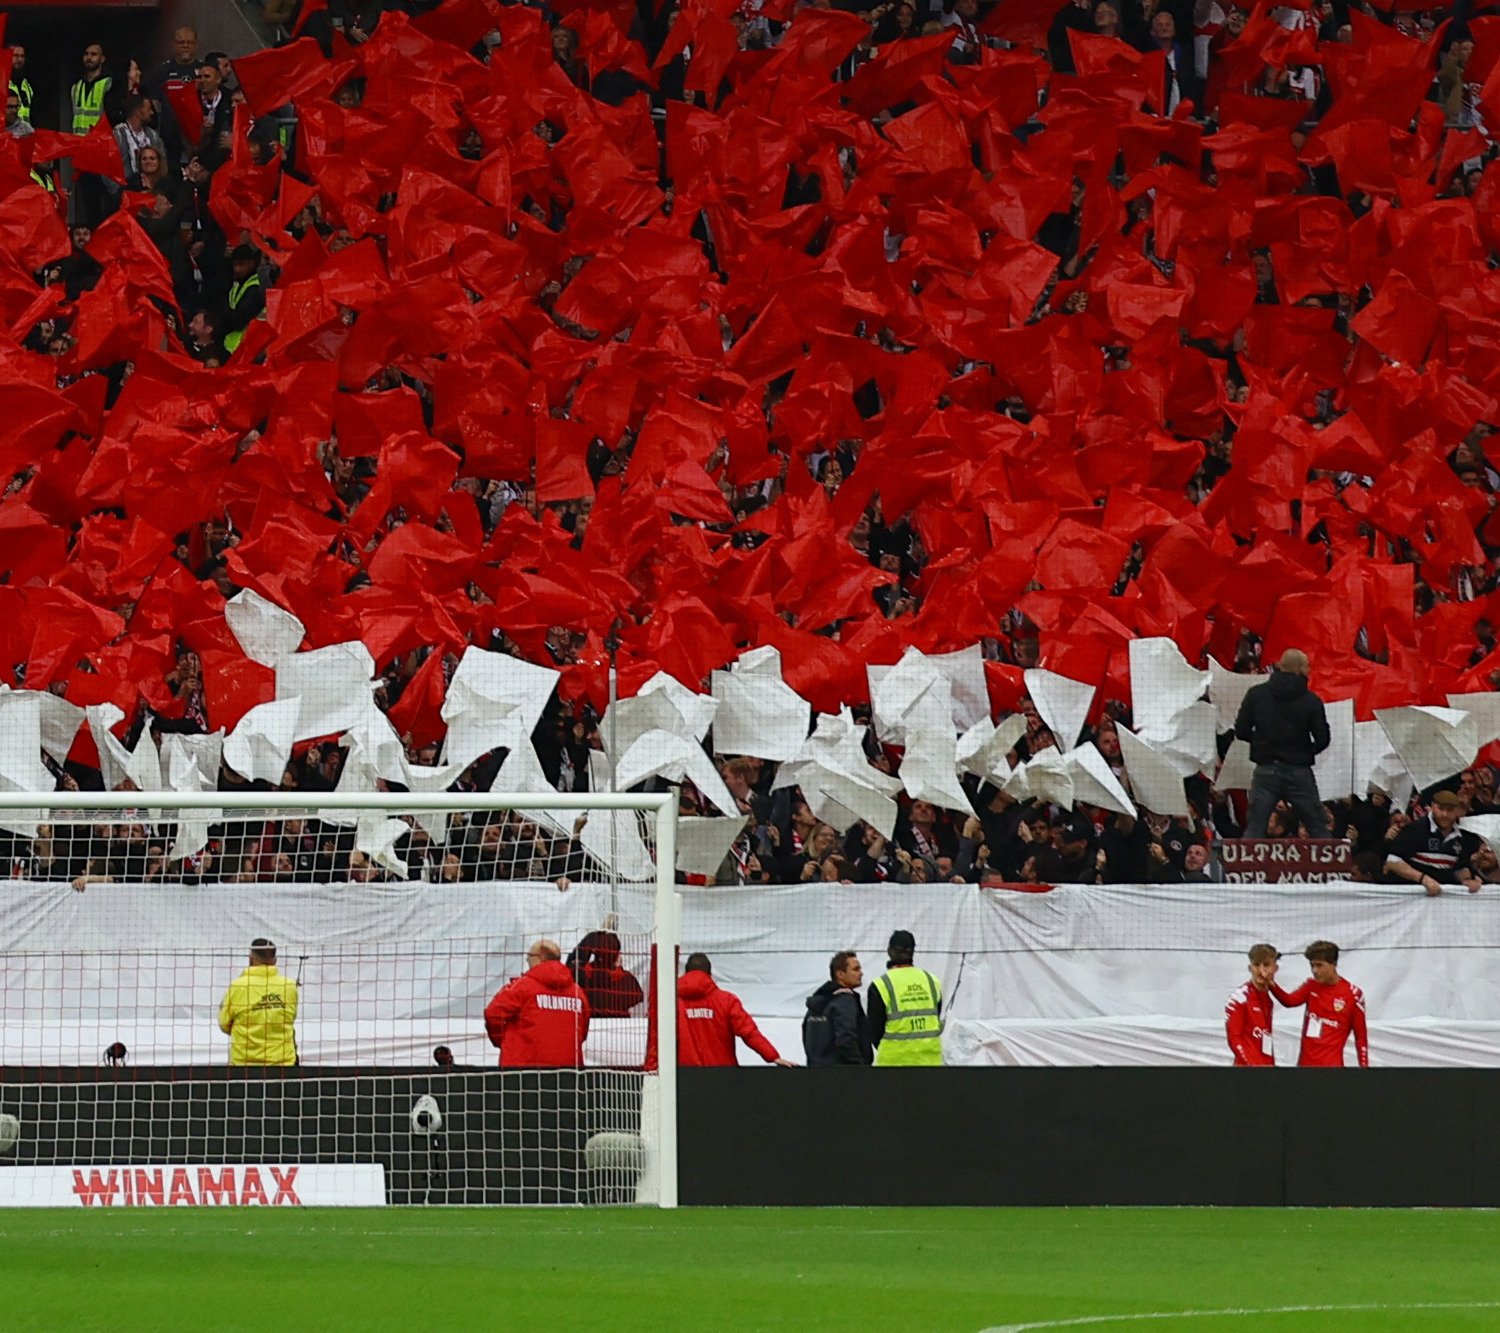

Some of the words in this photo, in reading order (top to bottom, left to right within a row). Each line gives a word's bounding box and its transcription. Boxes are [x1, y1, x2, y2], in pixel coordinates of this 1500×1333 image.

[1222, 843, 1301, 863] ULTRA
[1310, 844, 1352, 863] IST
[536, 993, 582, 1013] VOLUNTEER
[72, 1166, 303, 1206] WINAMAX
